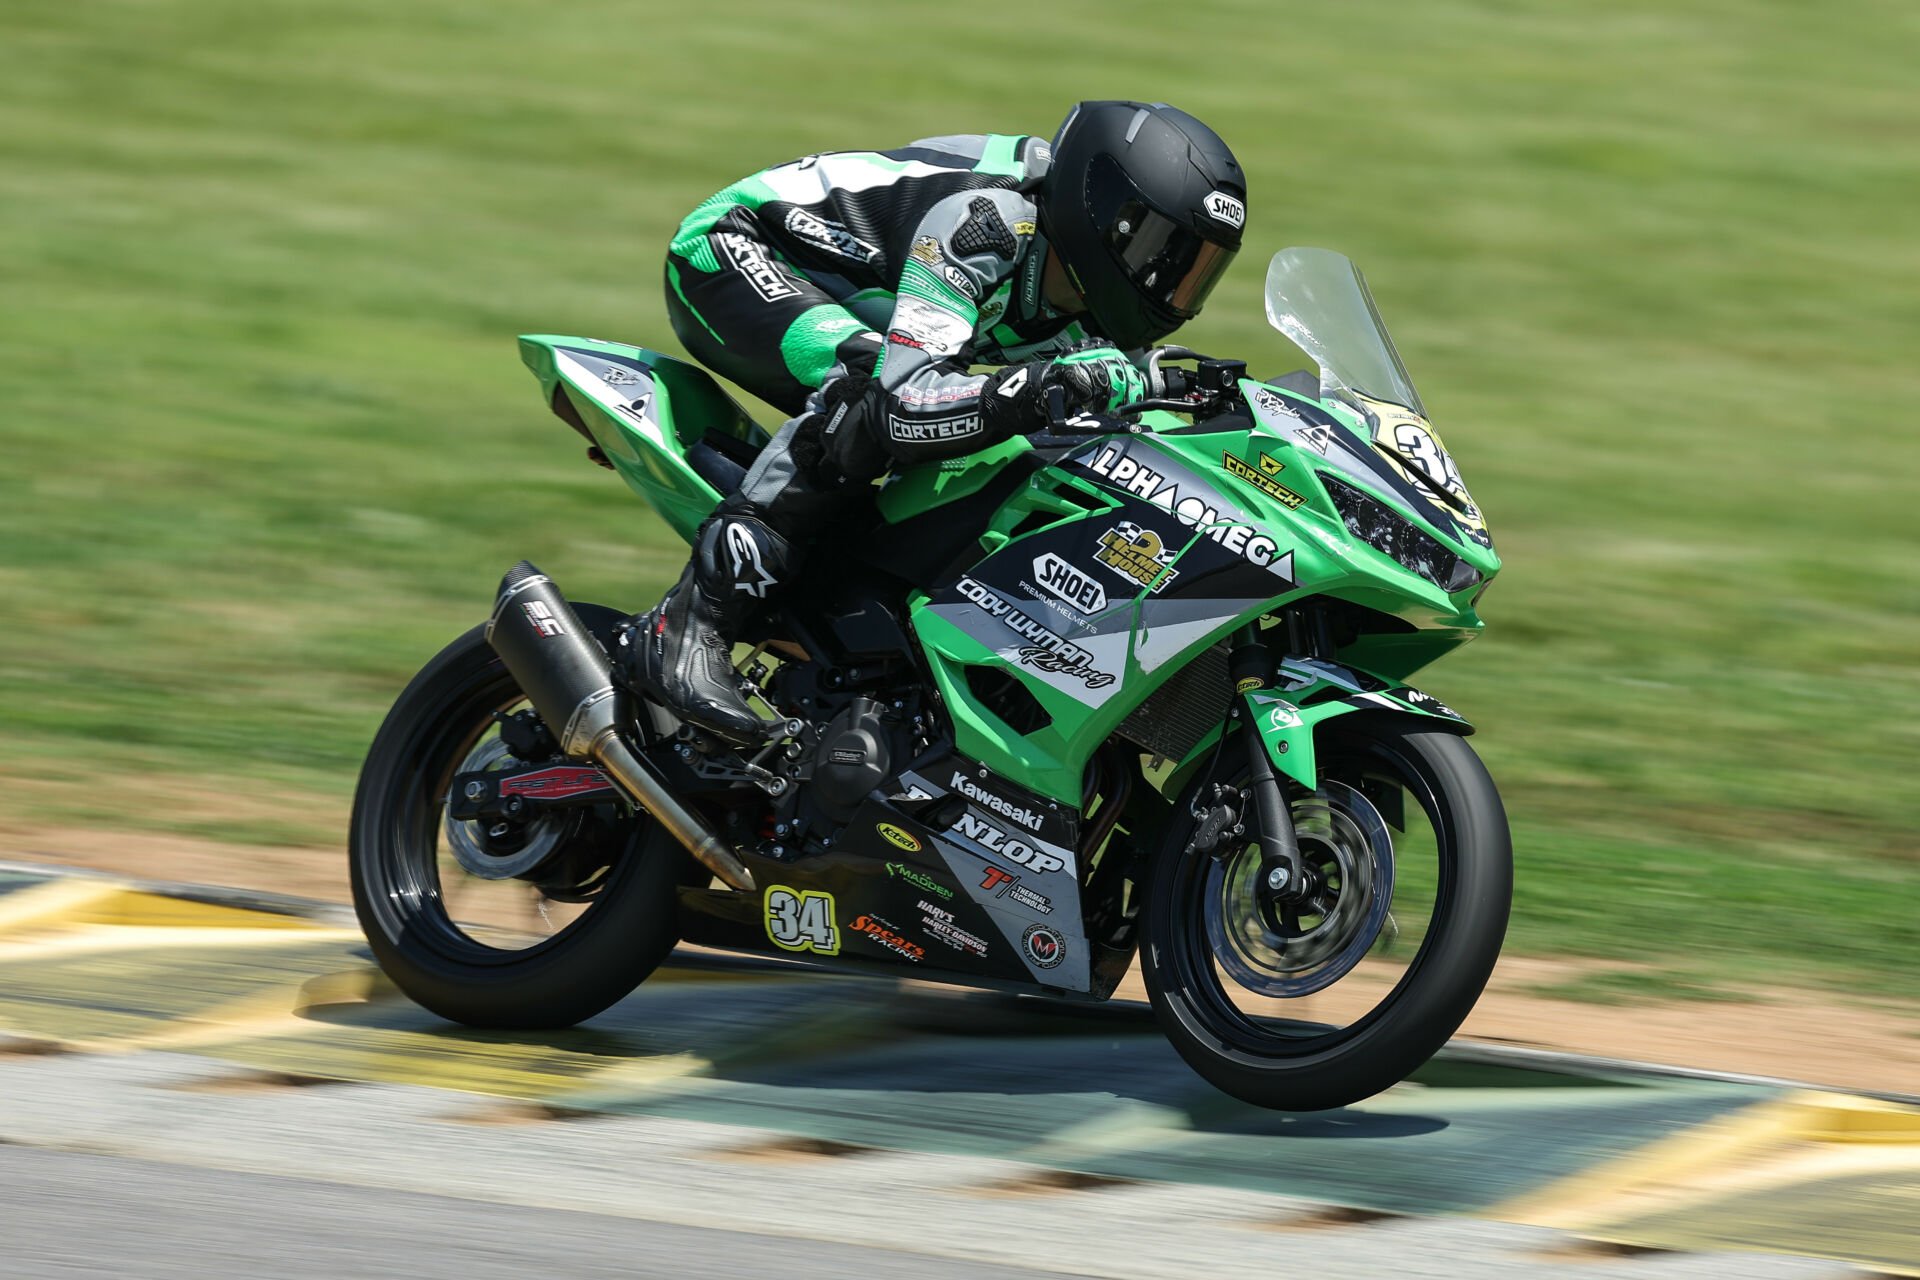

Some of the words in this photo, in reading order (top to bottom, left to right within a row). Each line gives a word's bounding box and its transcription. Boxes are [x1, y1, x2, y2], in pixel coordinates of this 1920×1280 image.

[1212, 197, 1243, 223] SHOEI
[893, 415, 980, 439] CORTECH
[1226, 455, 1300, 507] CORTECH
[1100, 549, 1166, 590] HOUSE
[1102, 530, 1173, 582] HELMET
[1038, 557, 1101, 611] SHOEI
[956, 577, 1011, 617] CODY
[1004, 608, 1094, 669] WYMAN
[1018, 579, 1057, 609] PREMIUM
[1056, 603, 1098, 635] HELMETS
[1020, 647, 1115, 688] Racing
[951, 771, 1044, 831] Kawasaki
[900, 866, 954, 899] MADDEN
[1010, 891, 1053, 914] TECHNOLOGY
[1016, 886, 1047, 905] THERMAL
[769, 890, 835, 951] 34
[848, 915, 927, 957] Spears
[922, 916, 988, 953] HARLEY-DAVIDSON
[867, 933, 919, 962] RACING
